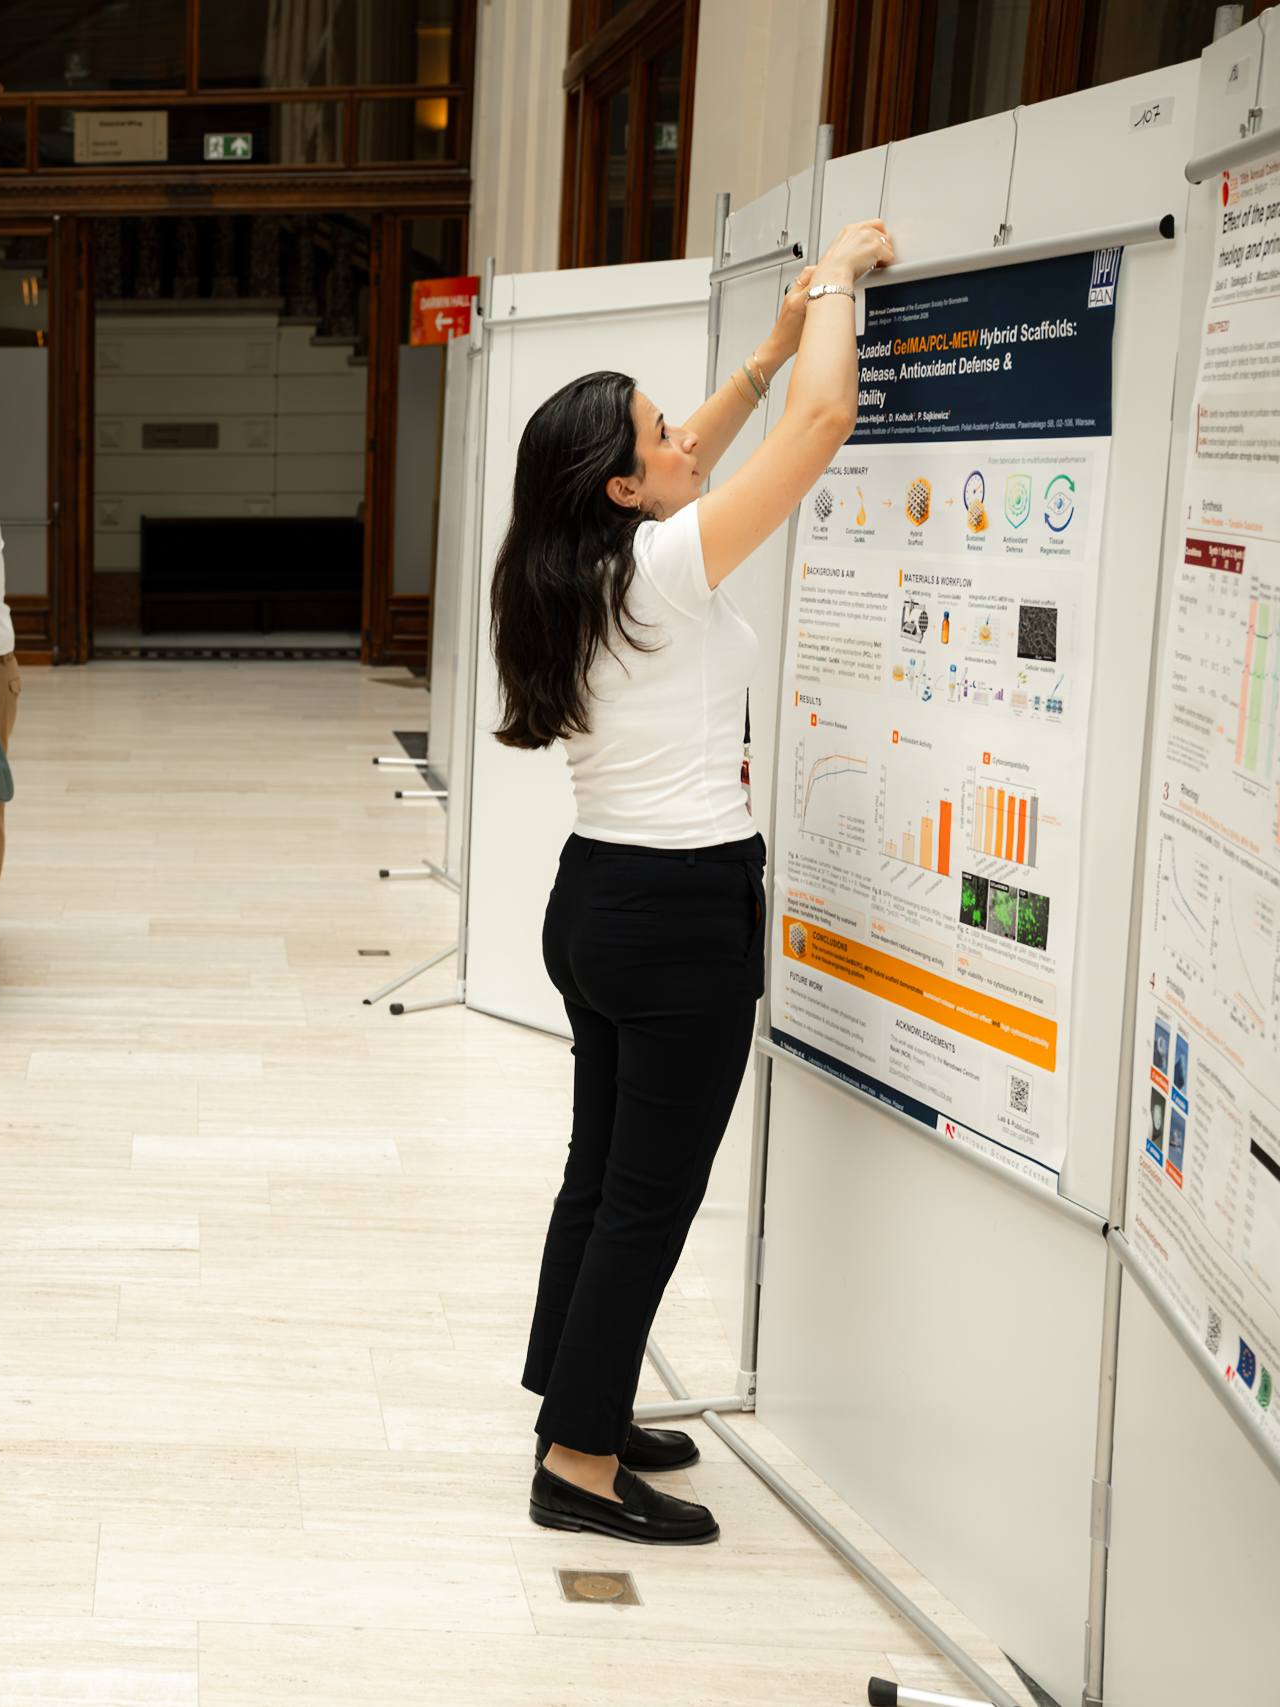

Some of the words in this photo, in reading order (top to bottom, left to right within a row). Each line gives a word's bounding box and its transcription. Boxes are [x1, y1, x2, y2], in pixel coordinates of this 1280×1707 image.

[1134, 104, 1161, 126] 107
[1252, 202, 1264, 226] the
[1246, 236, 1261, 260] and
[1090, 289, 1113, 306] PAN
[894, 330, 980, 355] GelMA/PCL-MEW
[980, 325, 1018, 350] Hybrid
[1021, 319, 1077, 342] Scaffolds:
[860, 366, 897, 382] Release,
[900, 359, 956, 379] Antioxidant
[959, 356, 1000, 374] Defense
[1003, 352, 1012, 370] &
[823, 467, 842, 475] APHICAL
[1049, 537, 1064, 545] Tissue
[1040, 547, 1071, 556] Regeneration
[806, 567, 840, 577] BACKGROUND
[904, 574, 934, 584] MATERIALS
[941, 577, 972, 588] WORKFLOW
[1163, 782, 1169, 800] 3
[812, 931, 848, 952] CONCLUSIONS
[790, 971, 808, 986] FUTURE
[808, 979, 823, 992] WORK
[957, 966, 967, 976] High
[968, 970, 983, 982] viability
[895, 1019, 956, 1053] ACKNOWLEDGEMENTS
[997, 1114, 1006, 1123] Lab
